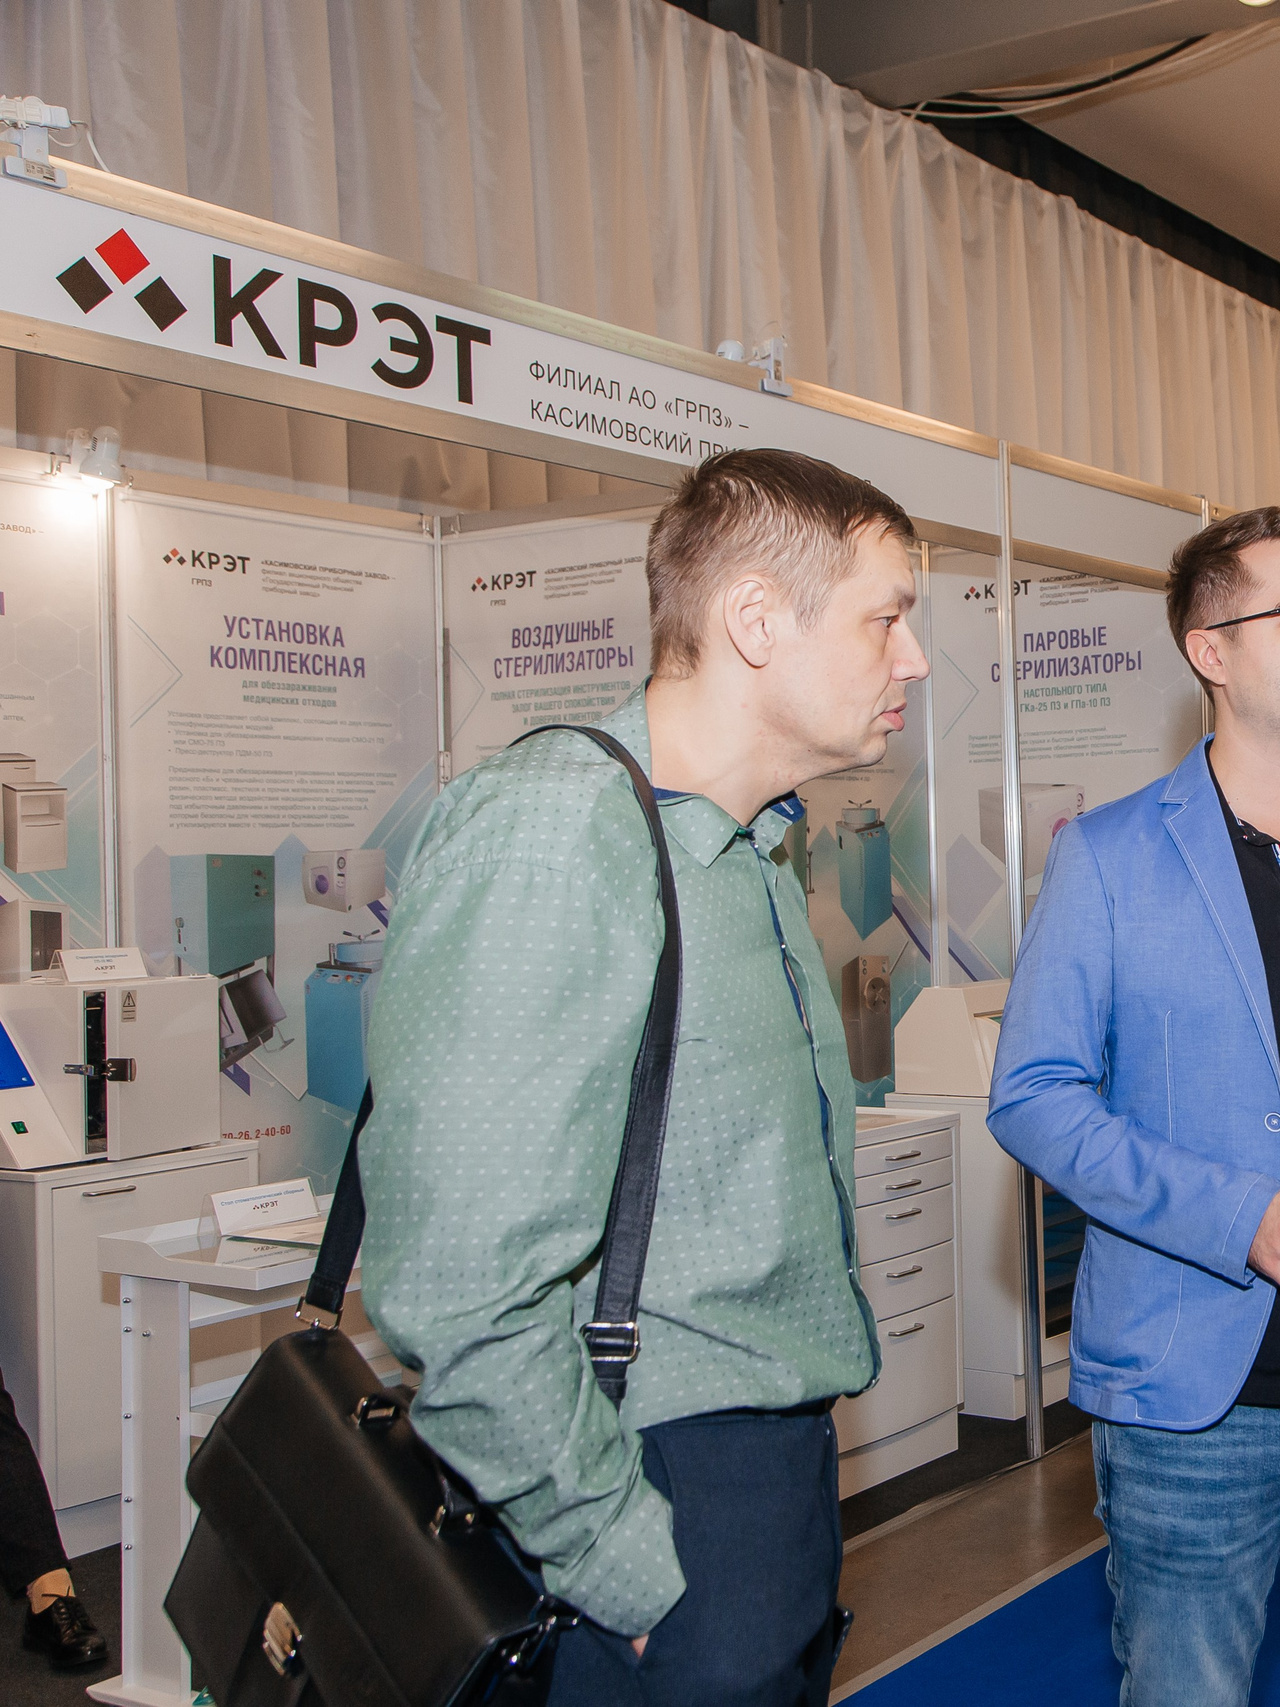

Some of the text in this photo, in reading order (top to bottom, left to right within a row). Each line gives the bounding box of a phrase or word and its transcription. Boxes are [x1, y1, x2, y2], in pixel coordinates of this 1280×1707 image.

[212, 254, 491, 405] КРЭТ
[529, 360, 621, 401] ФИЛИАЛ
[628, 386, 656, 409] АО
[664, 397, 732, 428] «ГРПЗ»
[530, 399, 692, 456] КАСИМОВСКИЙ
[191, 550, 250, 574] КРЭТ
[191, 577, 213, 587] ГРПЗ
[491, 570, 537, 591] КРЭТ
[984, 579, 1031, 599] КЭТ
[223, 615, 344, 648] УСТАНОВКА
[512, 617, 613, 649] ВОЗДУШНЫЕ
[1023, 626, 1106, 652] ПАРОВЫЕ
[210, 645, 364, 678] КОМПЛЕКСНАЯ
[494, 645, 633, 678] СТЕРИЛИЗАТОРЫ
[241, 680, 336, 693] для обеззараживания
[1023, 683, 1106, 698] НАСТОЛЬНОГО ТИПА
[243, 695, 336, 708] медицинских отходов
[1020, 702, 1047, 712] ГКа-25
[1050, 700, 1061, 710] ПЗ
[1071, 698, 1097, 708] ГПа-10
[1100, 696, 1110, 706] ПЗ
[255, 1124, 291, 1139] 2-40-60
[260, 1200, 279, 1209] КРЭТ
